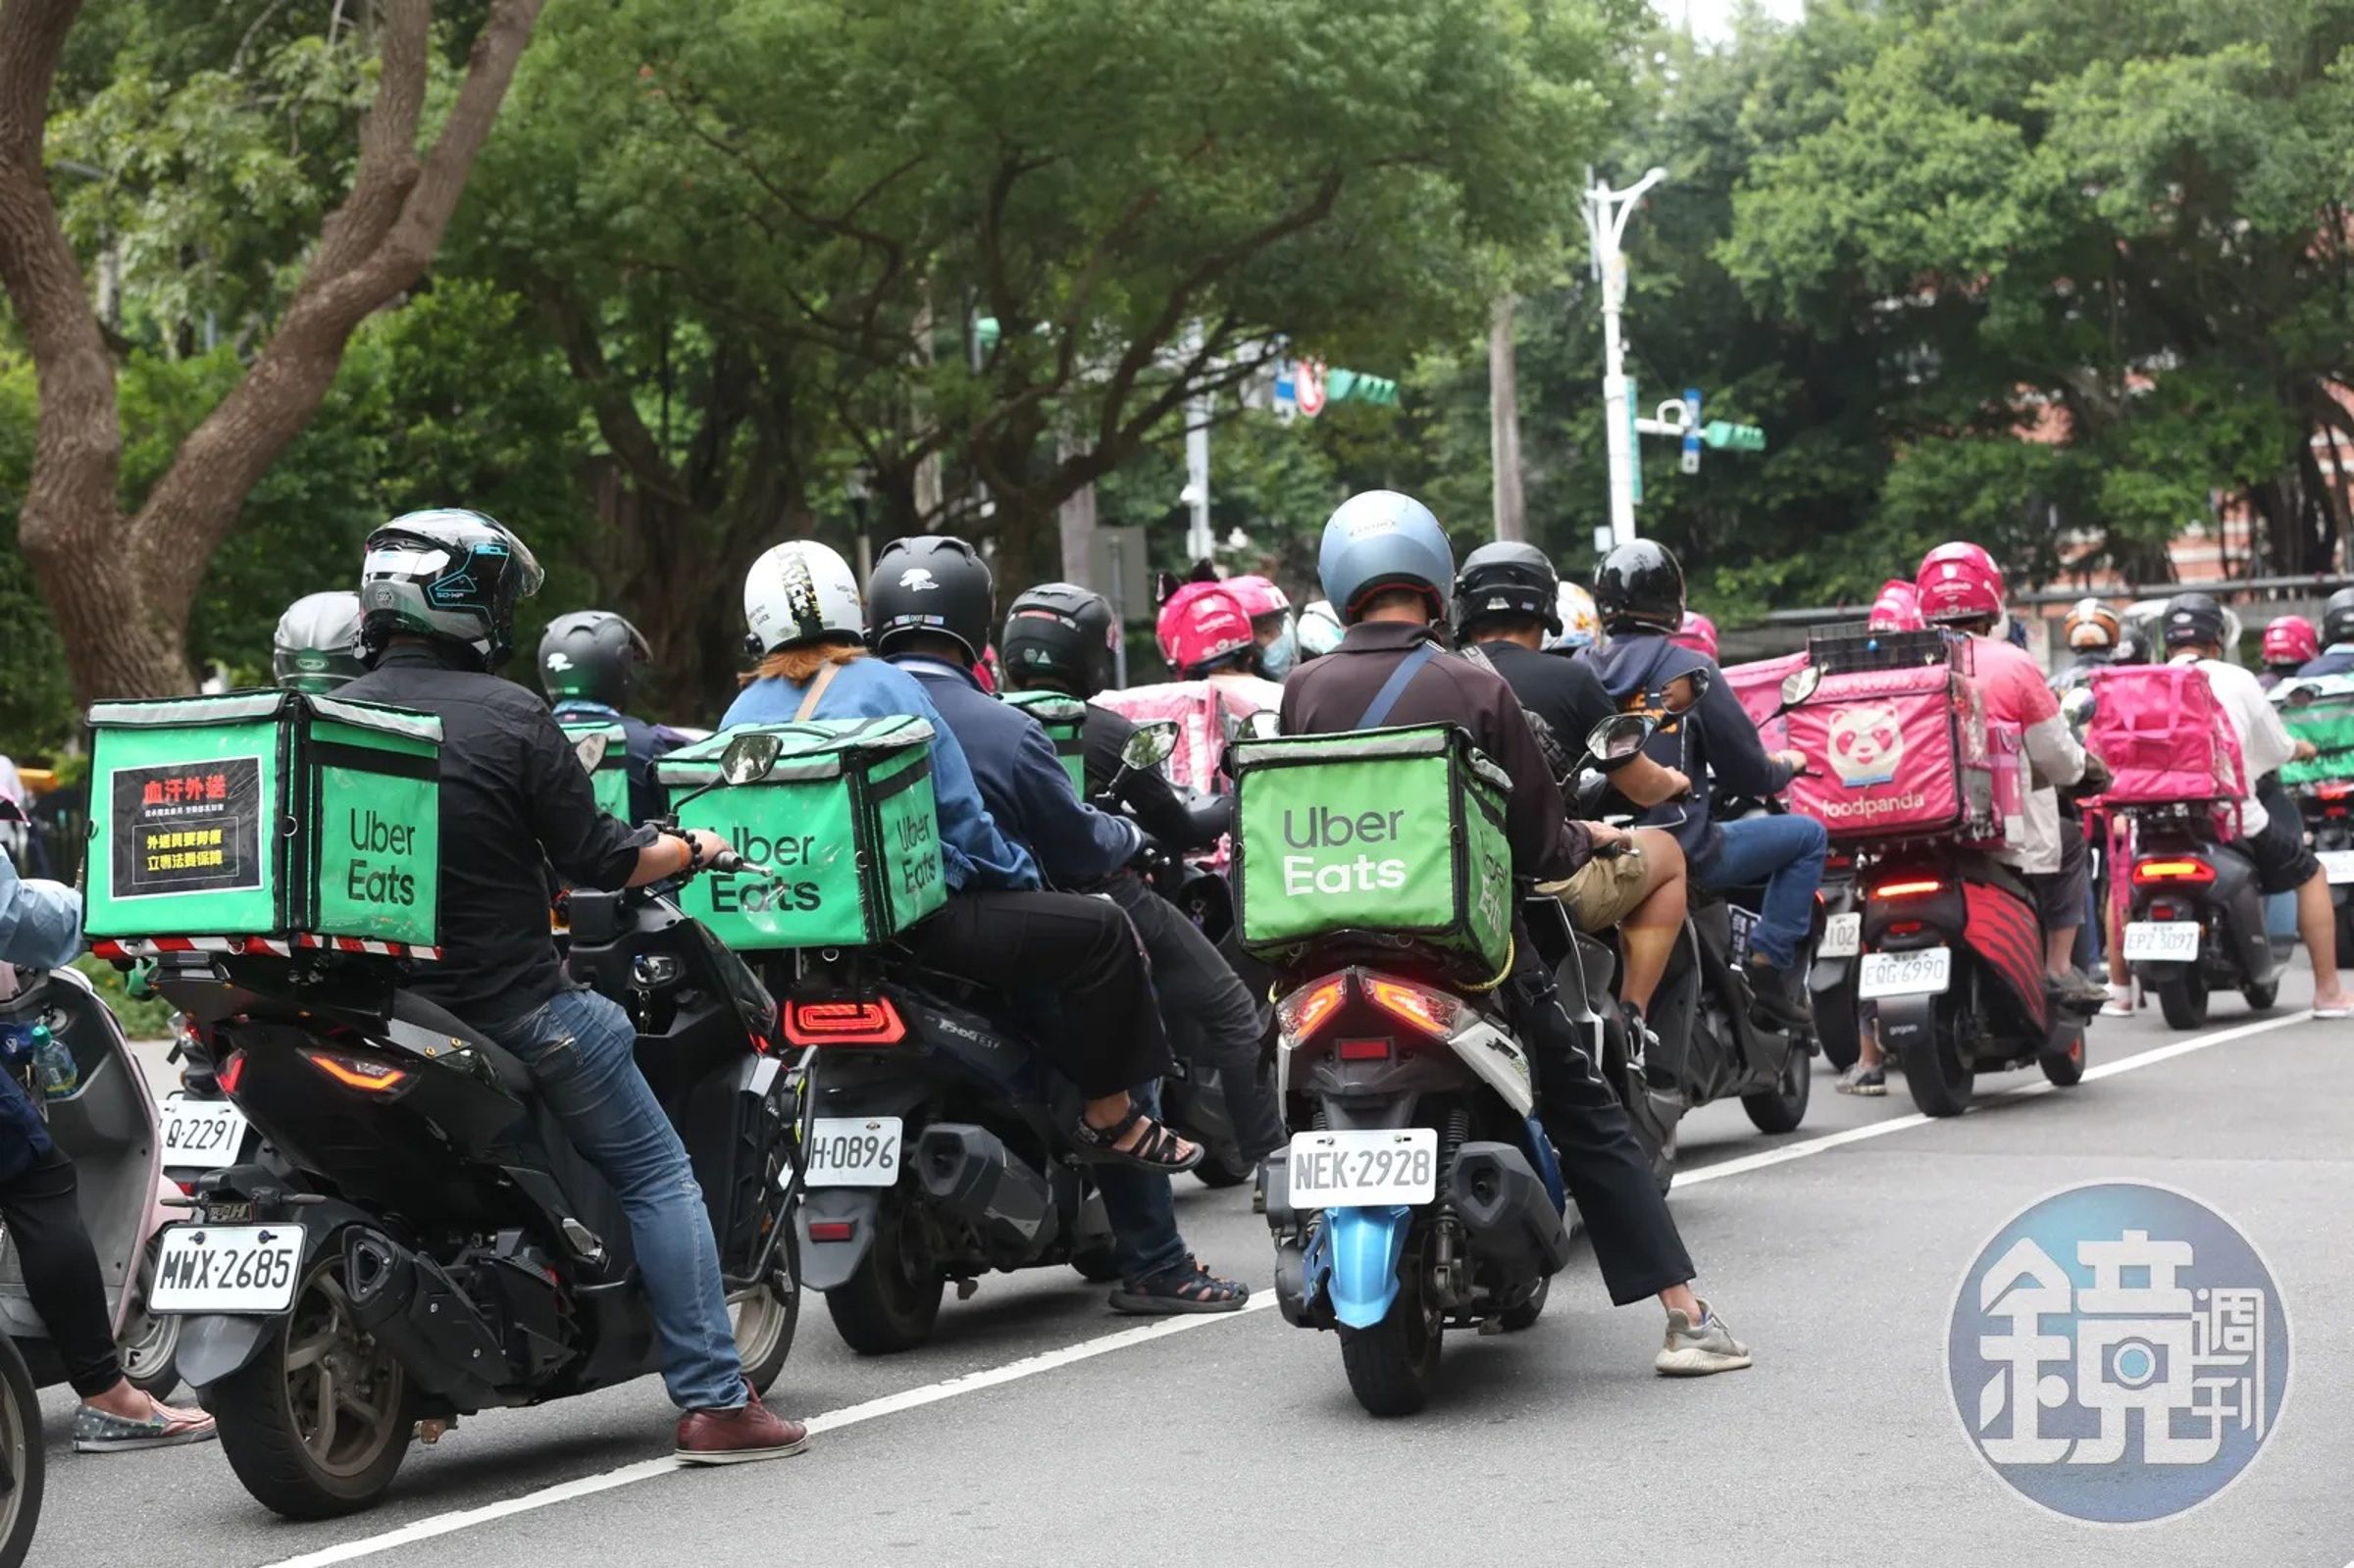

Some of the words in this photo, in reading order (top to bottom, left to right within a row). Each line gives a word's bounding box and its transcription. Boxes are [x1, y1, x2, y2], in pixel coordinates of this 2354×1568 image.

[1822, 792, 1925, 819] foodpanda
[350, 808, 416, 856] Uber
[897, 813, 932, 851] Uber
[1283, 806, 1405, 849] Uber
[348, 858, 416, 907] Eats
[901, 850, 937, 894] Eats
[1283, 854, 1407, 896] Eats
[710, 874, 822, 913] Eats
[1826, 925, 1857, 947] 102
